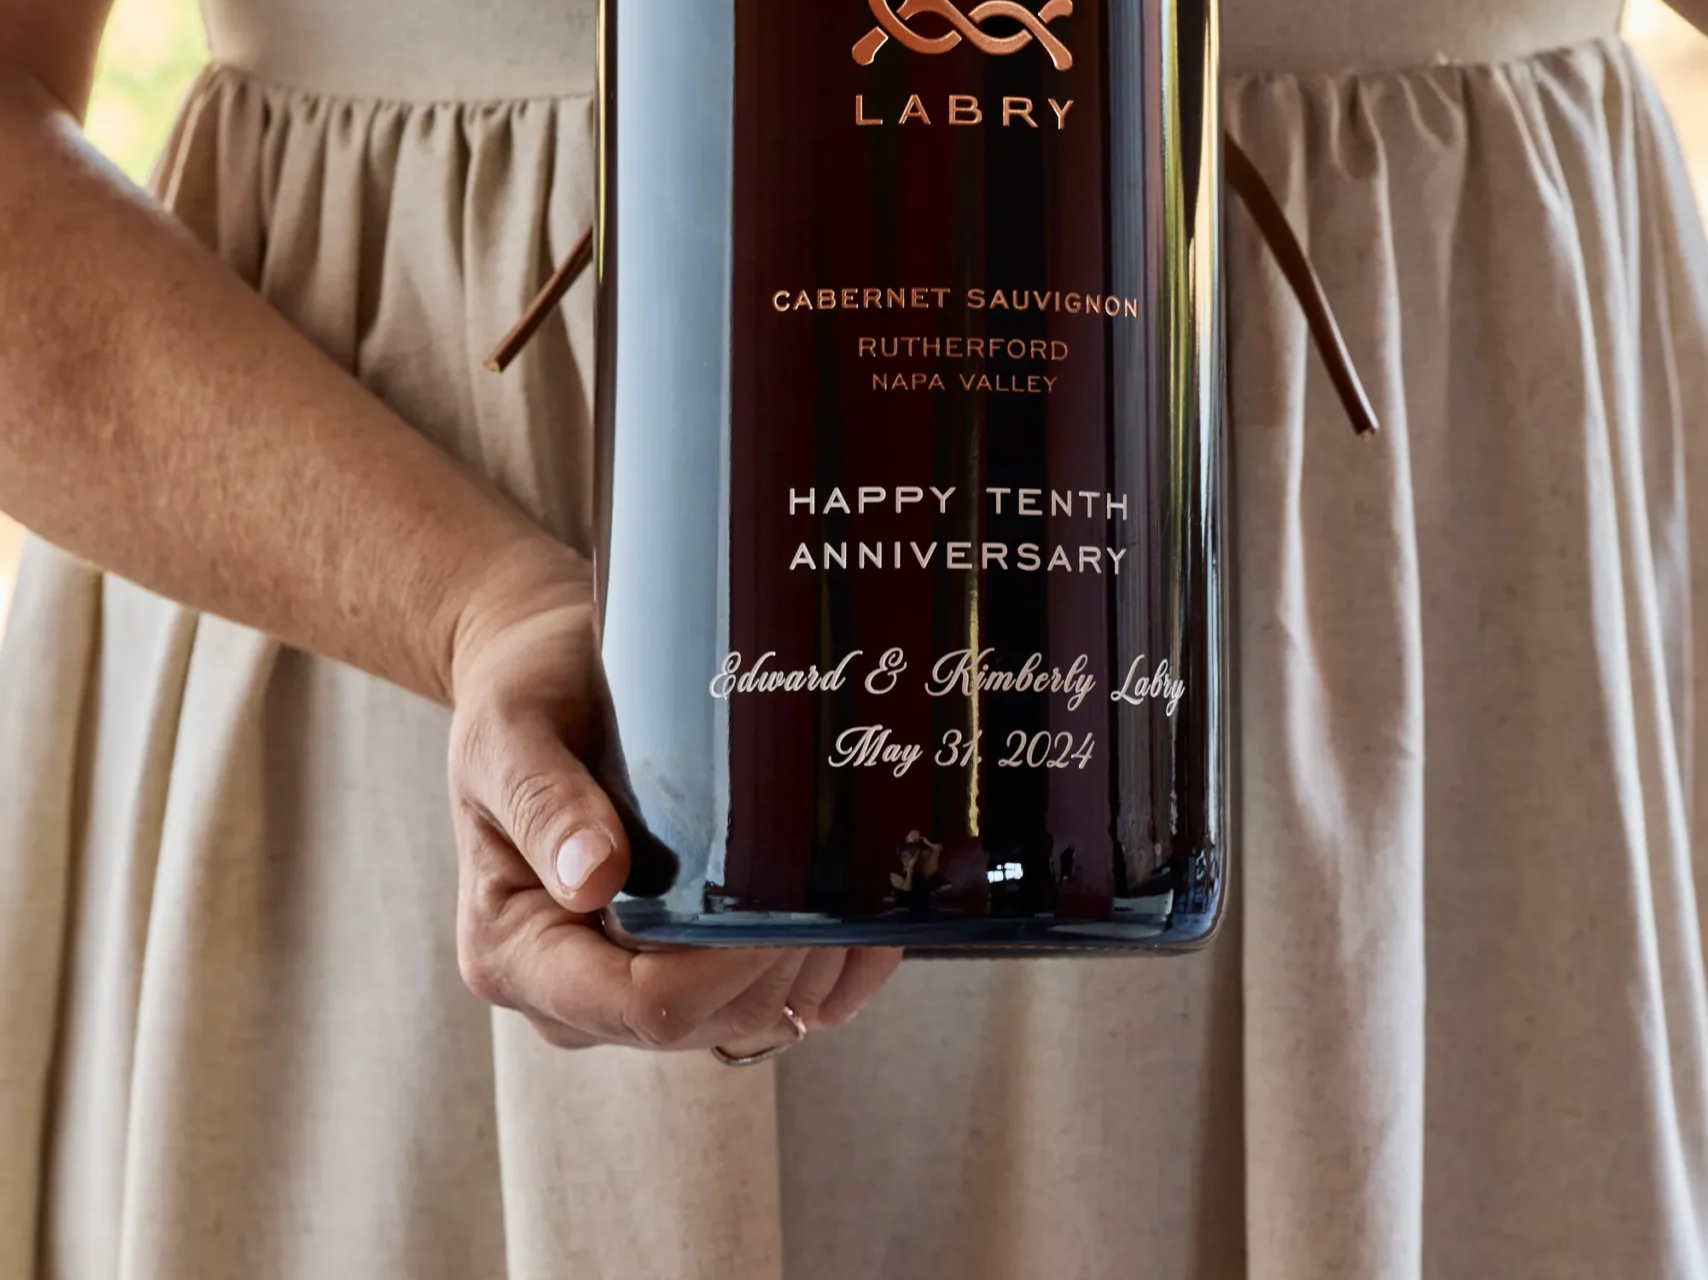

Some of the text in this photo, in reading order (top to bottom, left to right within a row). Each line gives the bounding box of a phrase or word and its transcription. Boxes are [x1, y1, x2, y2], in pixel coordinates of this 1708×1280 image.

[856, 94, 1073, 130] LABRY
[772, 287, 1138, 318] CABERNET SAUVIGNON
[858, 337, 1069, 361] RUTHERFORD
[872, 373, 1058, 394] NAPA VALLEY
[789, 485, 1128, 521] HAPPY TENTH
[789, 541, 1127, 576] ANNIVERSARY
[709, 647, 1185, 717] Edward & Kimberly Labry
[828, 724, 923, 778] May
[998, 730, 1094, 770] 2024
